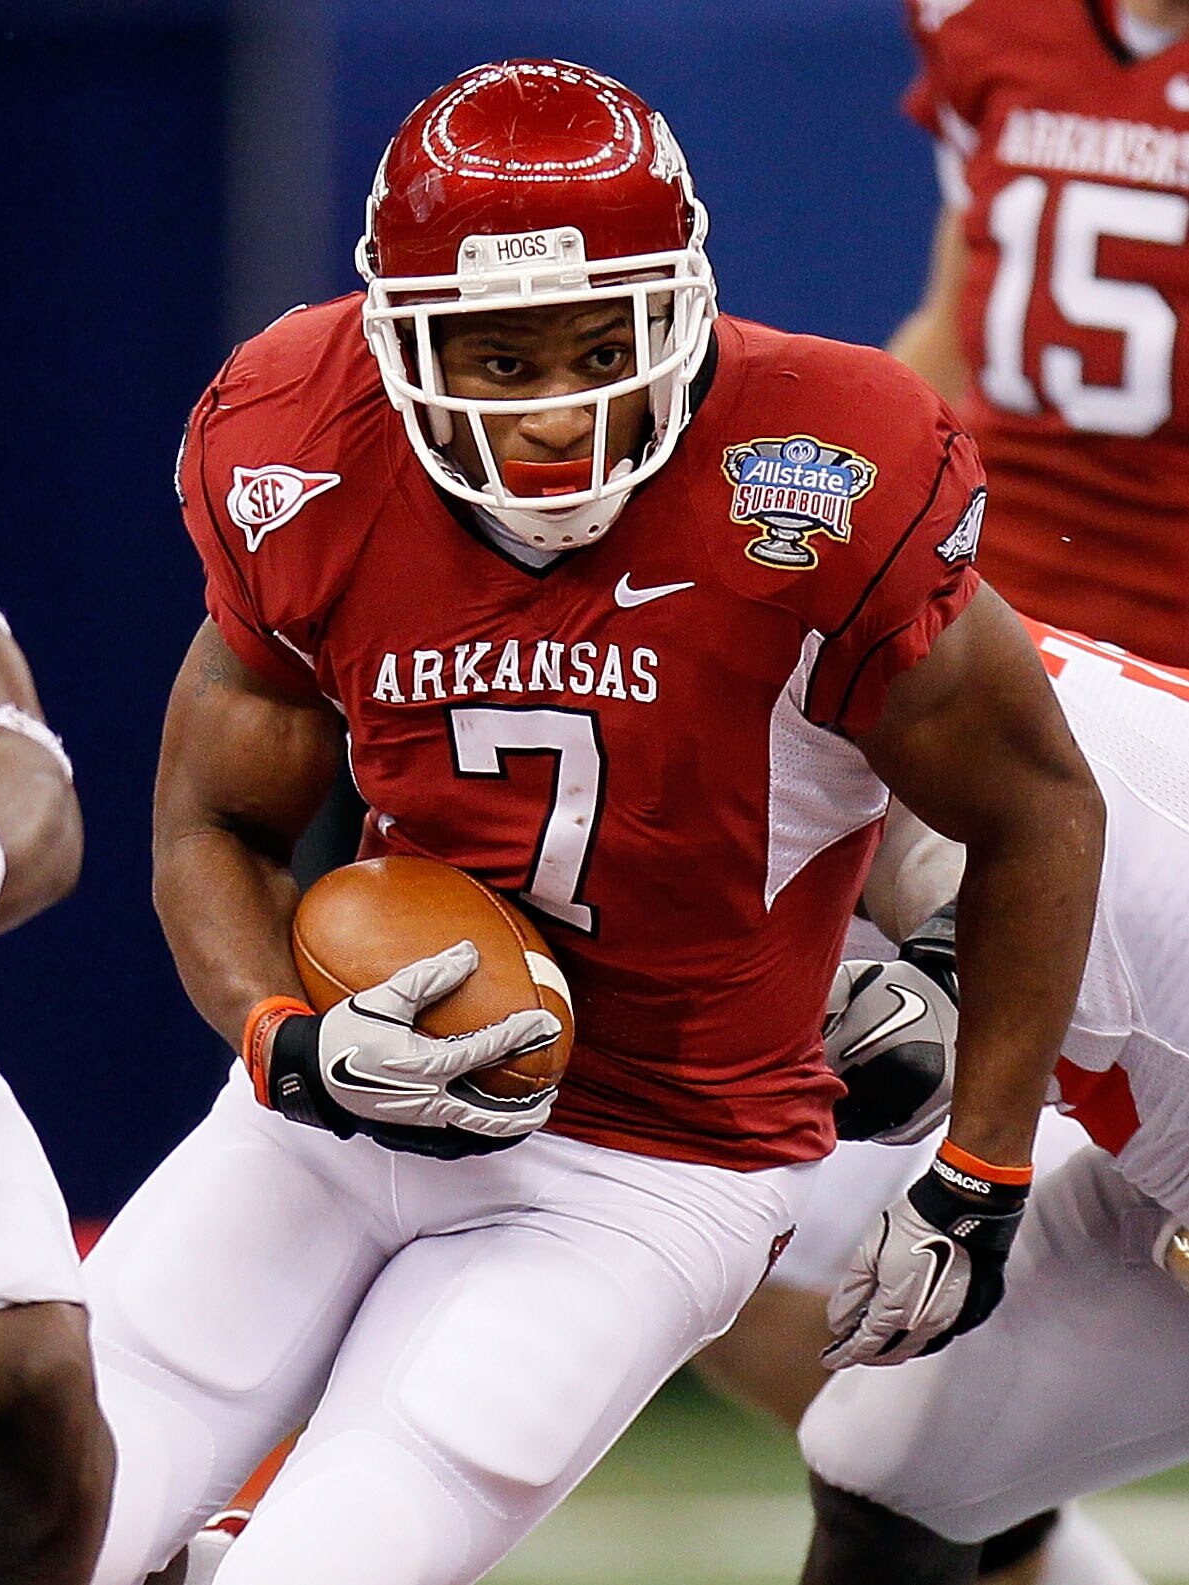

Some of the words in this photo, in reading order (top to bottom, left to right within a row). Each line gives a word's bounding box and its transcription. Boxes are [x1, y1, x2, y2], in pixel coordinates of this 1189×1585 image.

[497, 234, 547, 260] HOGS
[979, 175, 1189, 437] 15
[249, 478, 285, 519] SEC
[372, 639, 659, 703] ARKANSAS
[448, 704, 606, 936] 7
